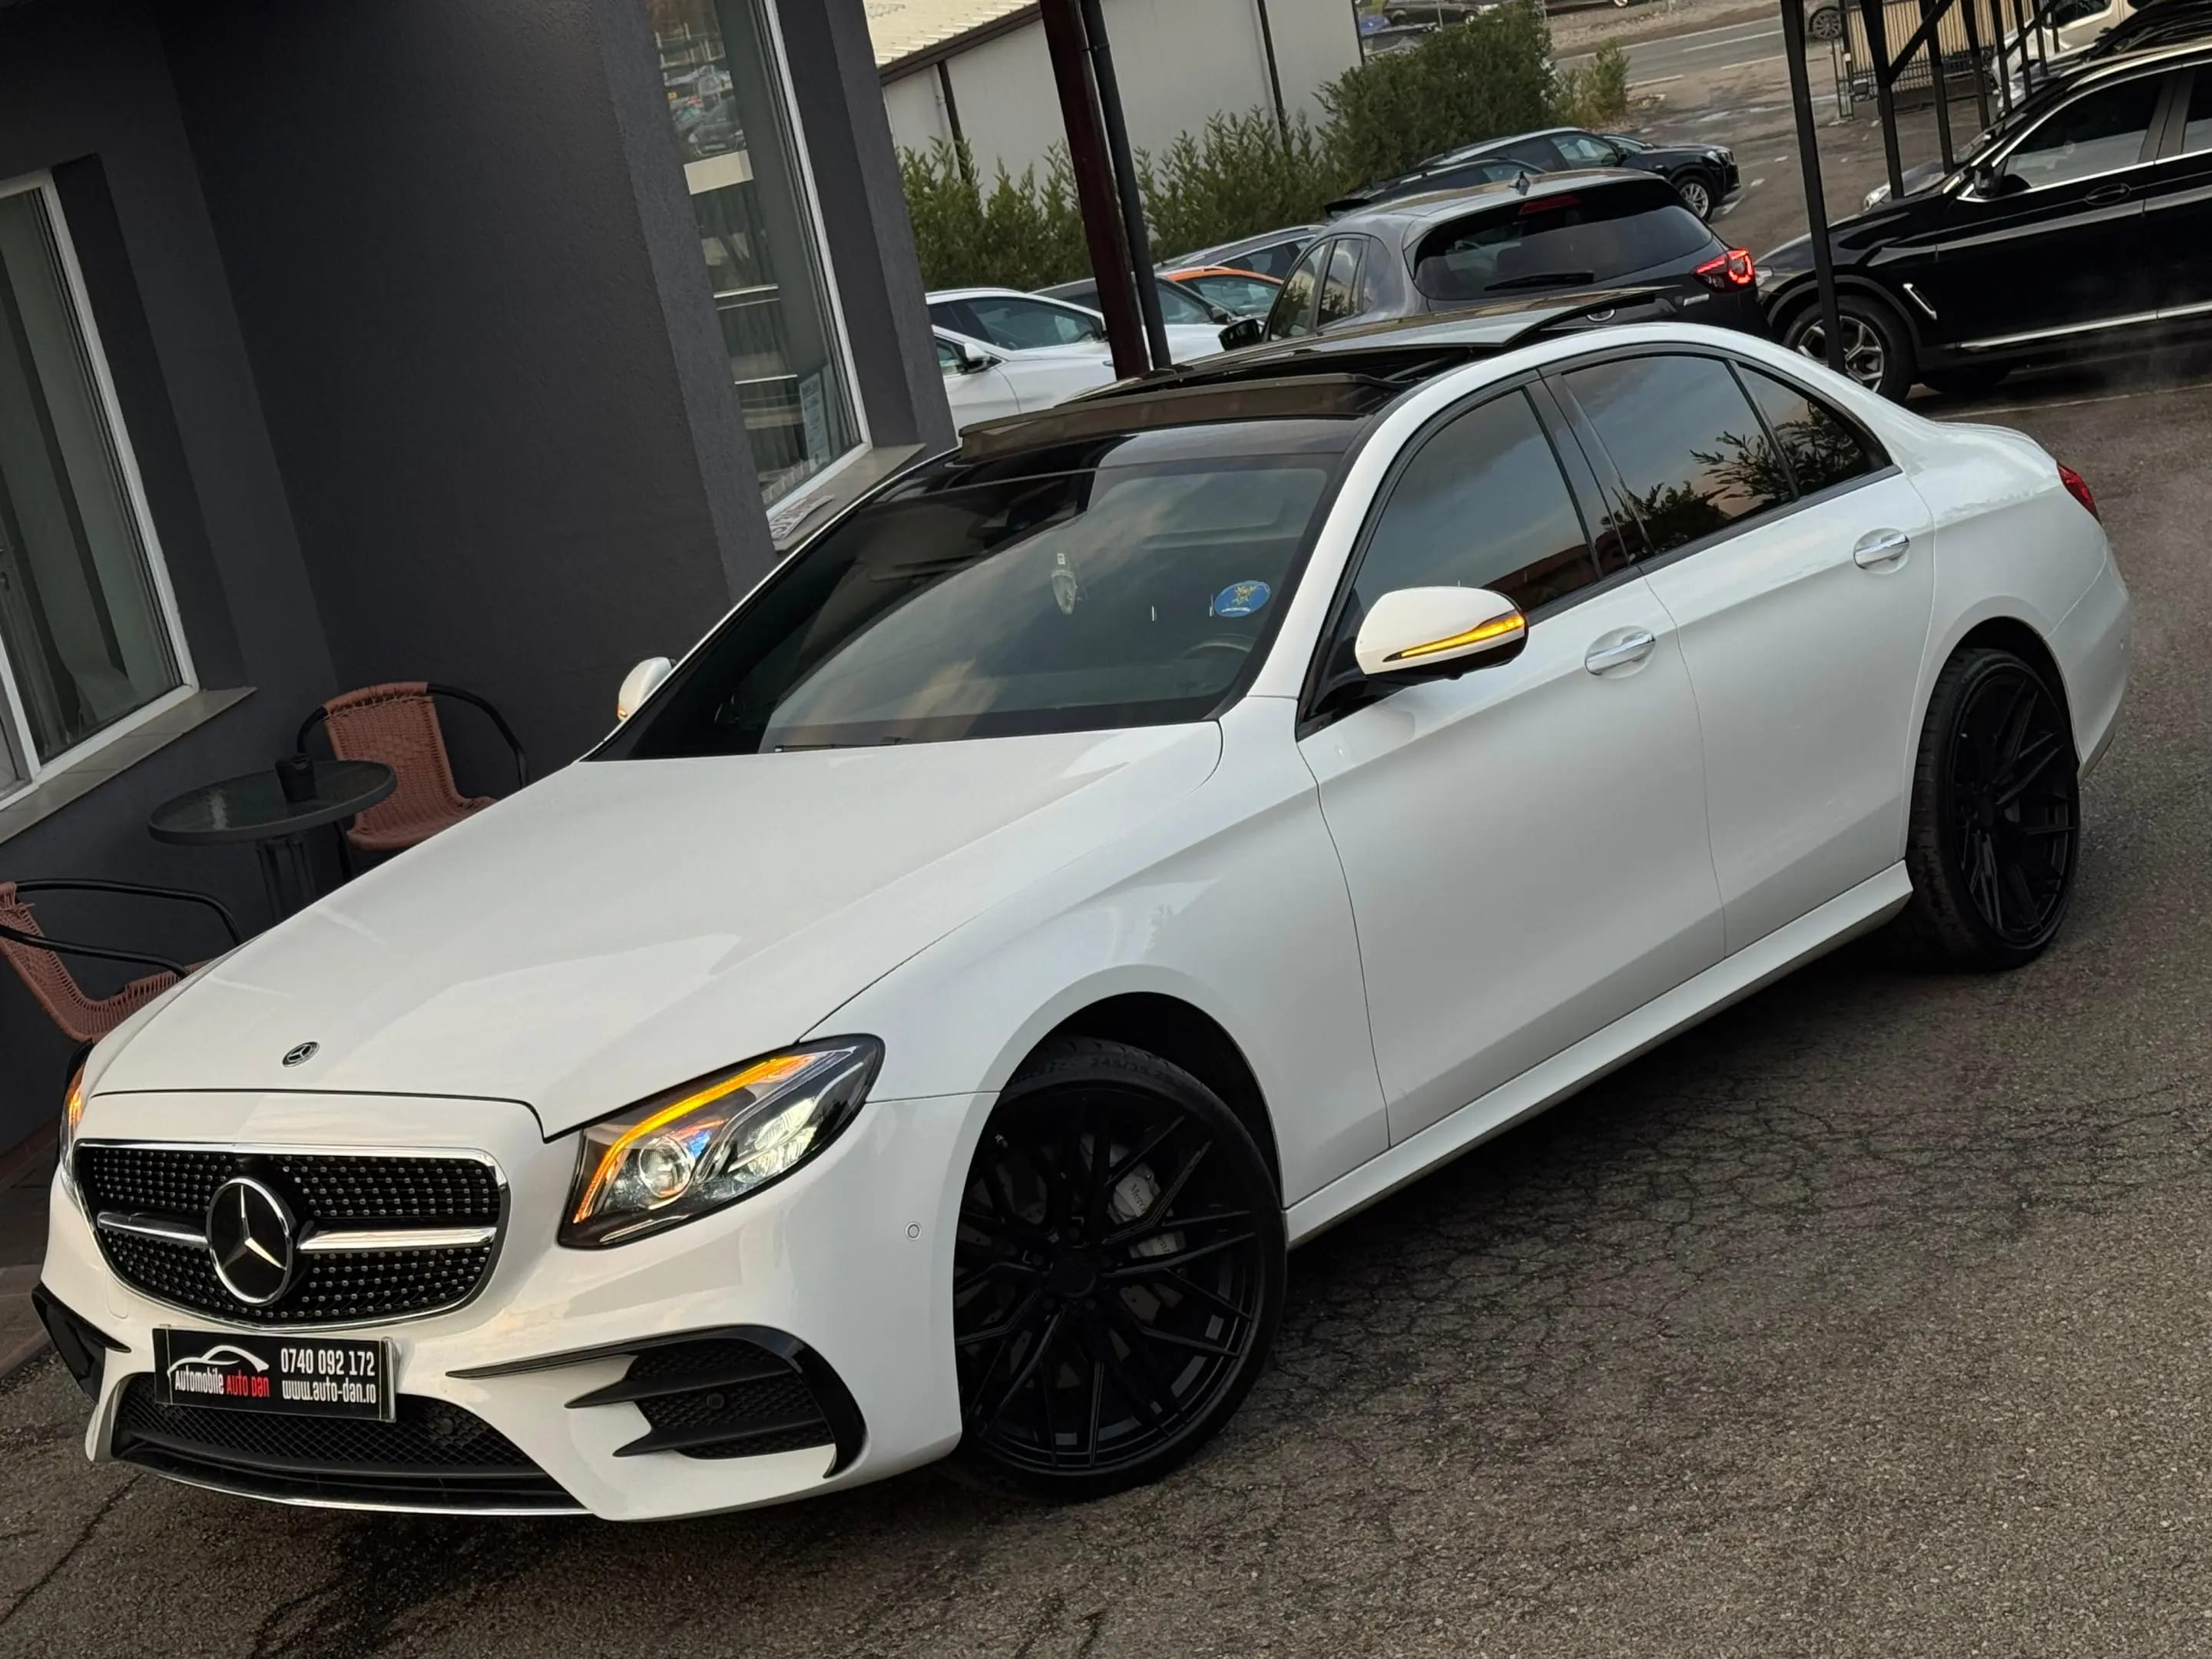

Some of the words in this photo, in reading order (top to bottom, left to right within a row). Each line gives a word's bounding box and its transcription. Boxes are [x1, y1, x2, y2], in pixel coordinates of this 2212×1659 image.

[280, 1347, 314, 1374] 0740
[318, 1349, 345, 1375] 092
[348, 1350, 376, 1376] 172
[174, 1364, 224, 1395] Automobile
[227, 1369, 249, 1397] Auto
[282, 1376, 376, 1404] www.auto-dan.ro
